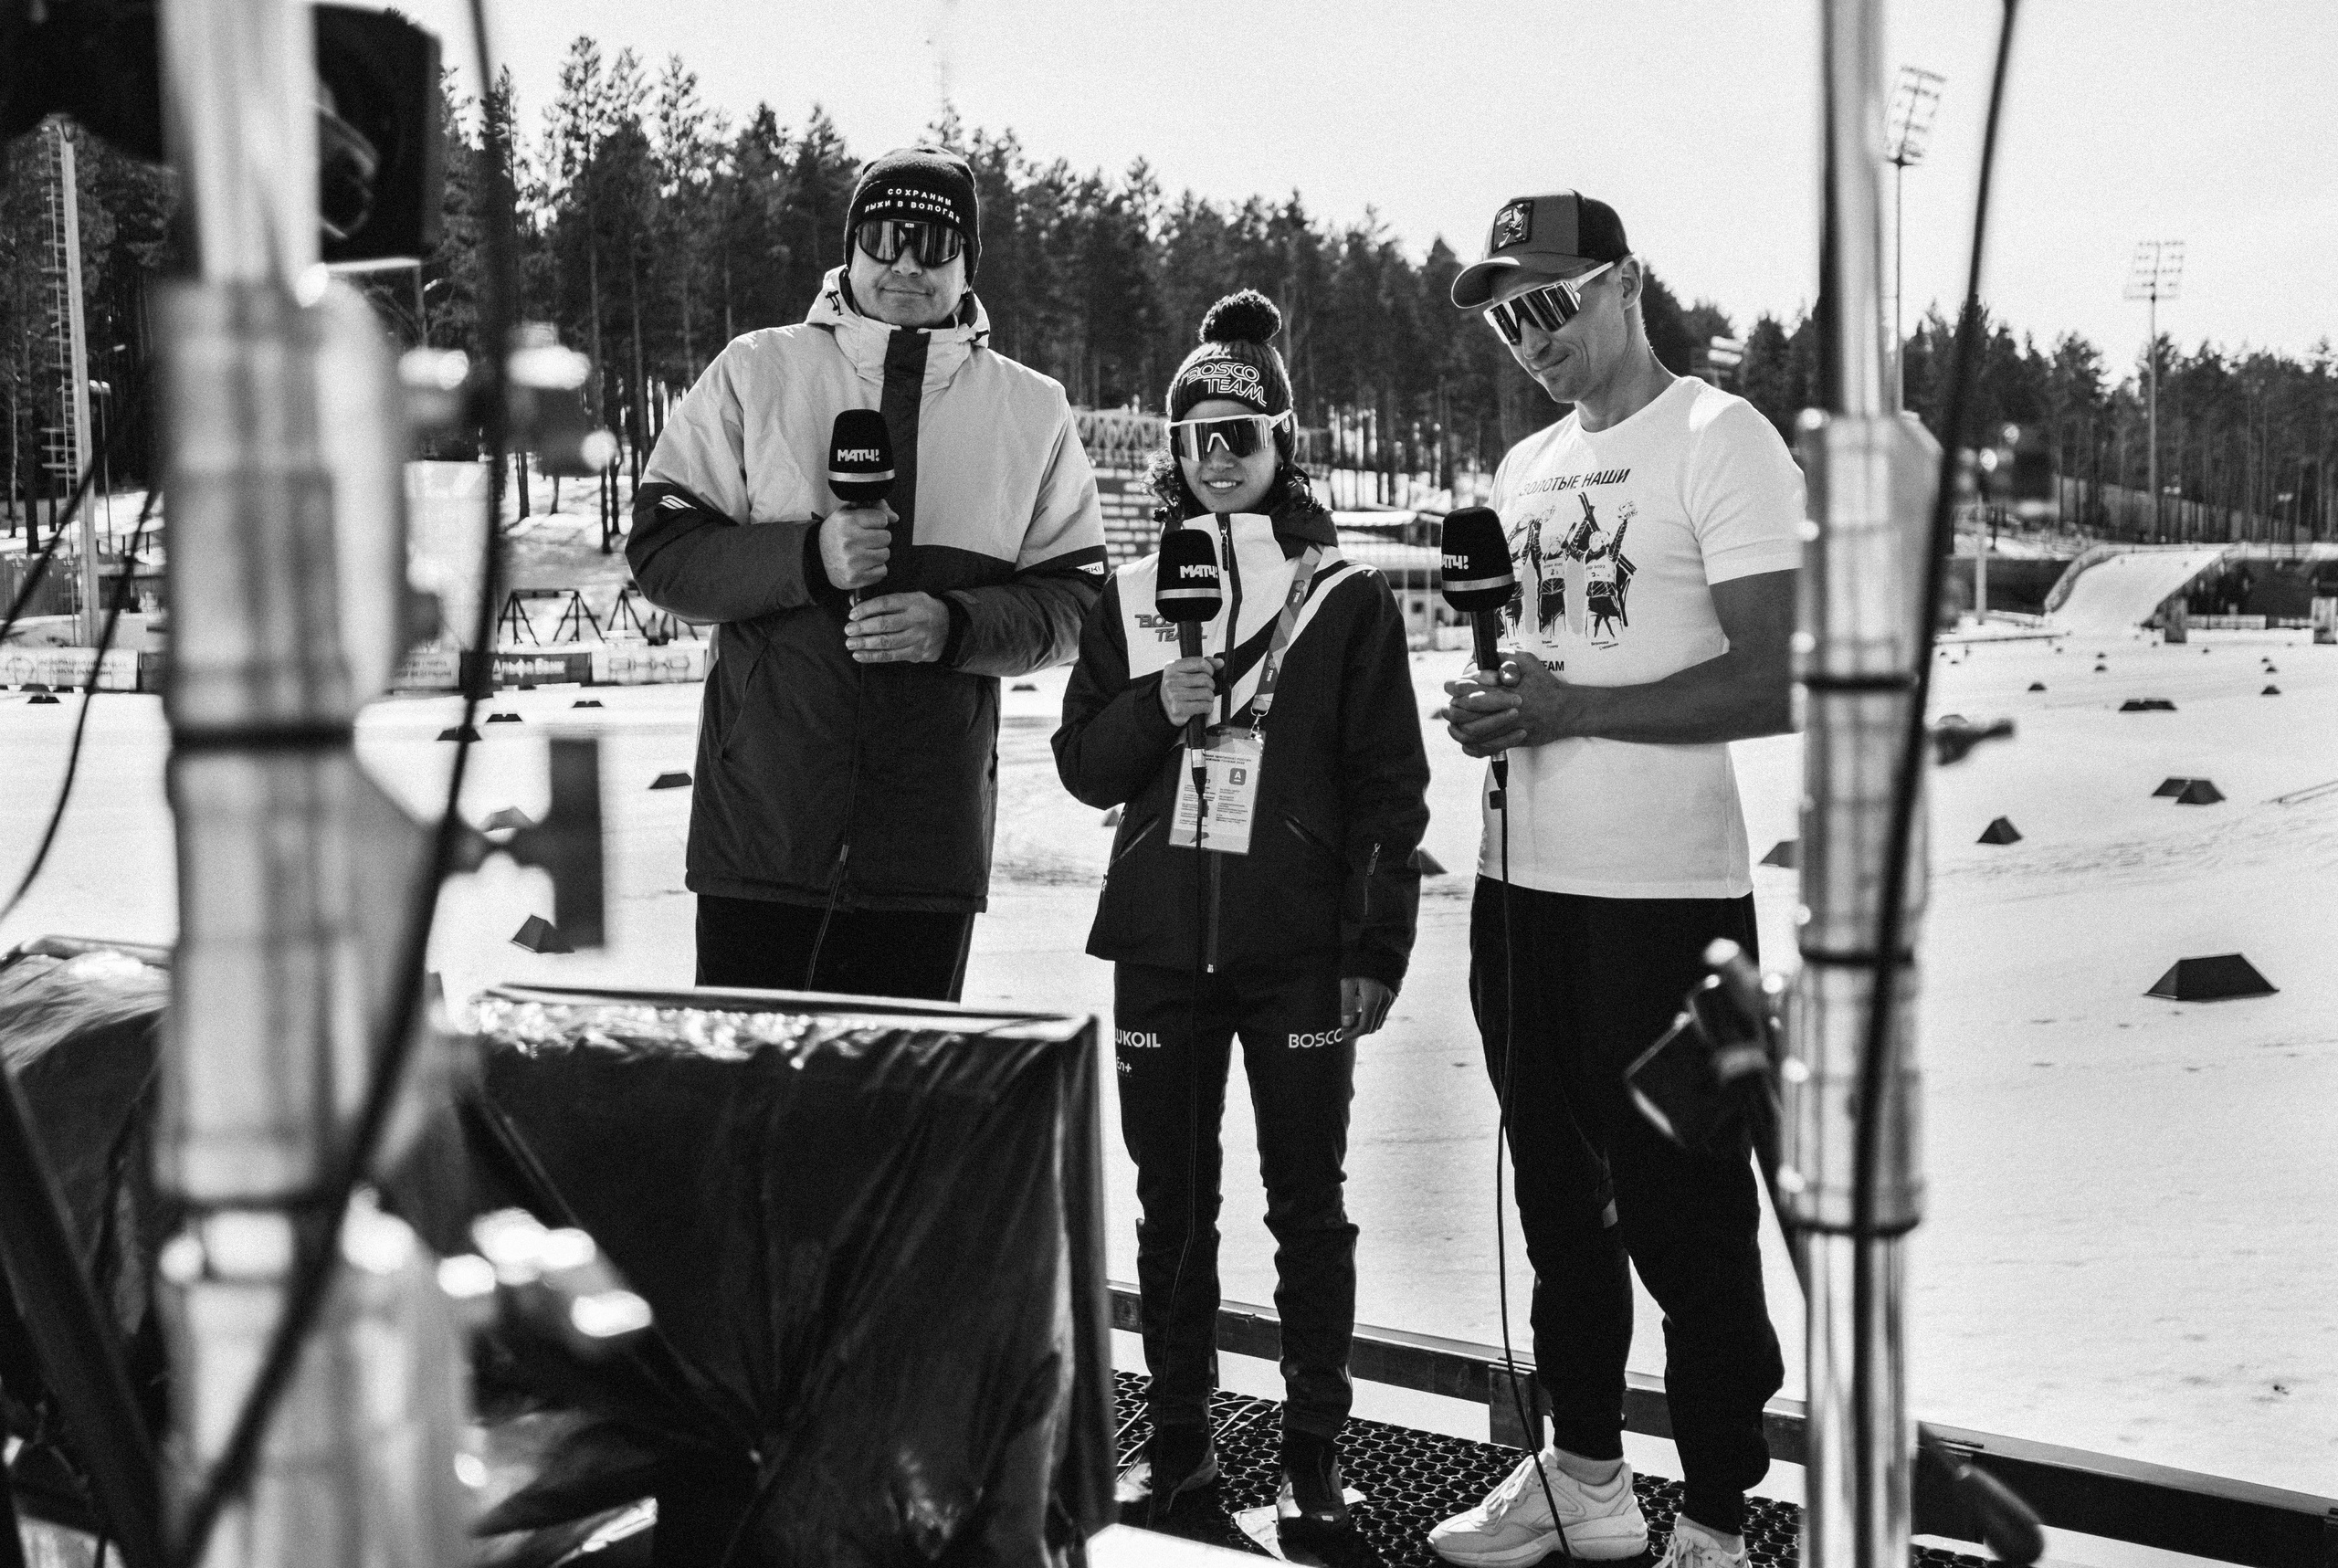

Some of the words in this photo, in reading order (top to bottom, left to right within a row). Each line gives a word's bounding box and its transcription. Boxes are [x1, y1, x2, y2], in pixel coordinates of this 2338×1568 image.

[888, 188, 952, 206] СОХРАНИМ
[865, 200, 890, 213] ЛЫЖИ
[897, 200, 903, 208] В
[1179, 362, 1260, 384] BOSCO
[1203, 377, 1268, 406] TEAM
[837, 448, 880, 462] МАТЧ!
[1582, 468, 1631, 488] НАШИ
[1442, 553, 1469, 570] АТЧ!
[1180, 564, 1218, 579] МАТЧ!
[1540, 660, 1564, 671] EAM
